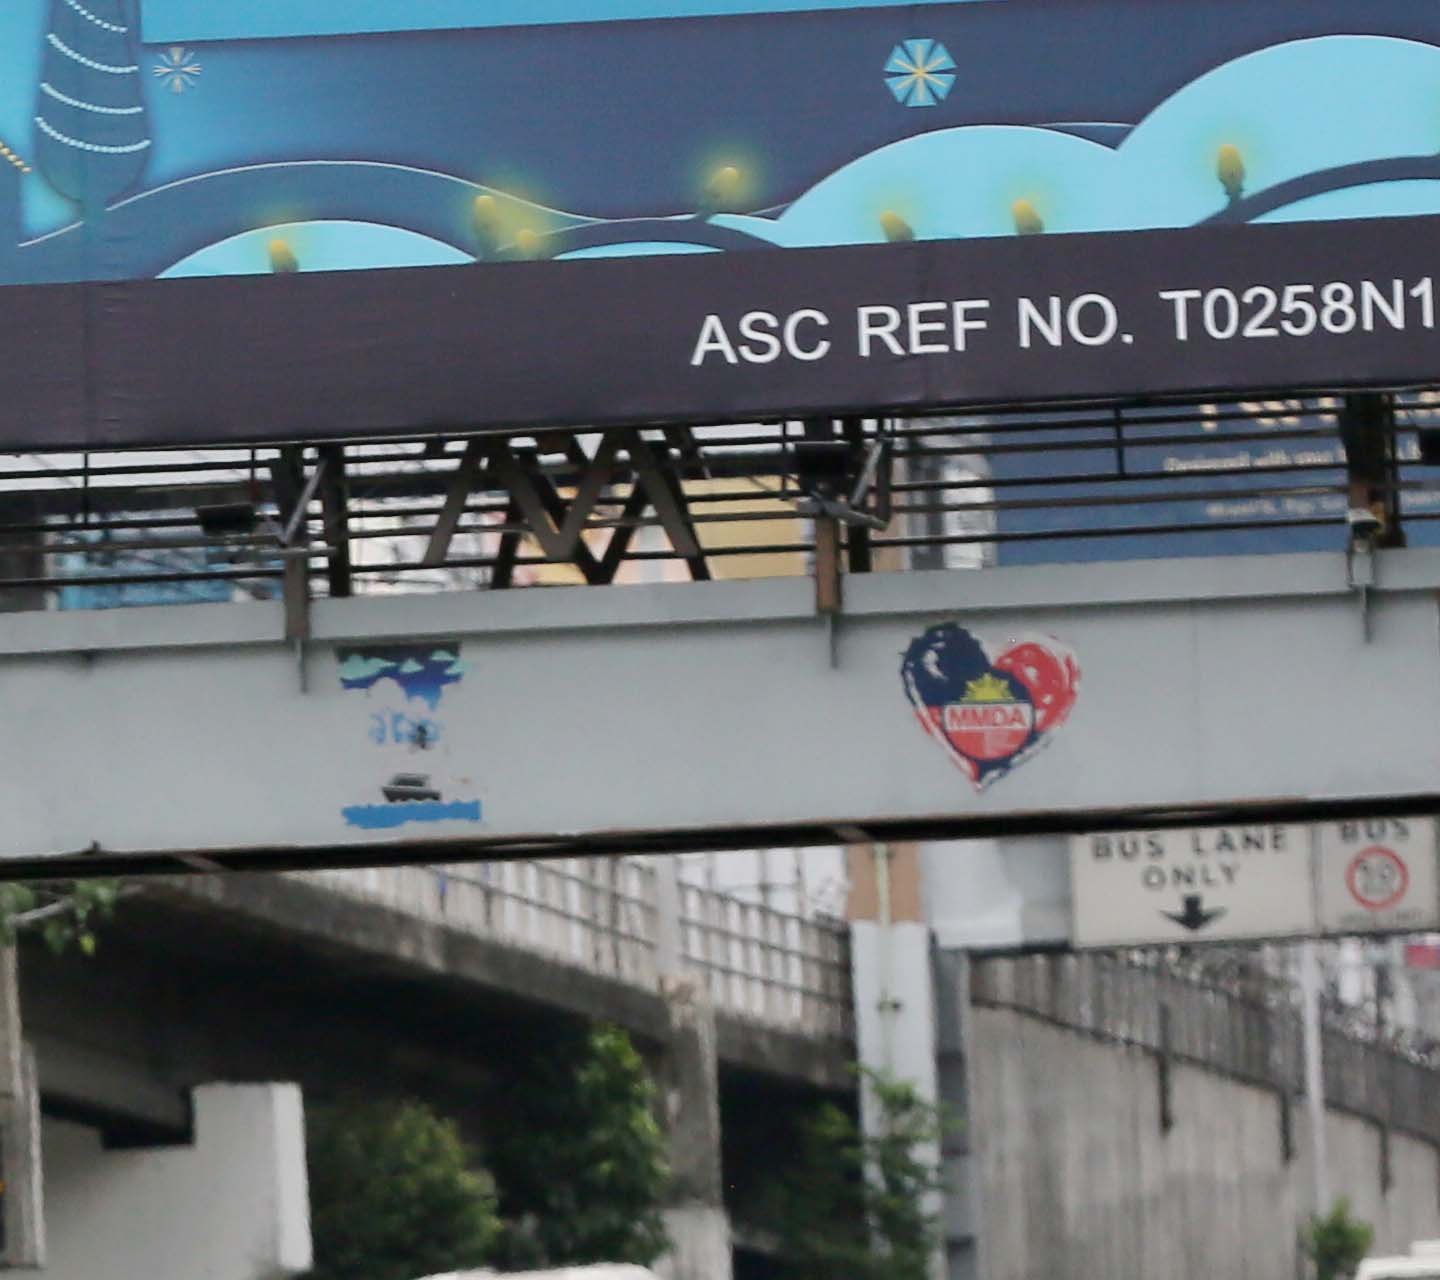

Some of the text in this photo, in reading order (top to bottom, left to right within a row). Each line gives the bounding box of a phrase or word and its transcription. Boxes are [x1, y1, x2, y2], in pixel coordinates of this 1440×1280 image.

[691, 309, 829, 368] ASC
[858, 299, 988, 358] REF
[1018, 292, 1134, 350] NO.
[948, 706, 1027, 728] MMDA
[1092, 825, 1289, 861] BUS LANE
[1339, 820, 1412, 843] BUS
[1141, 863, 1242, 890] ONLY
